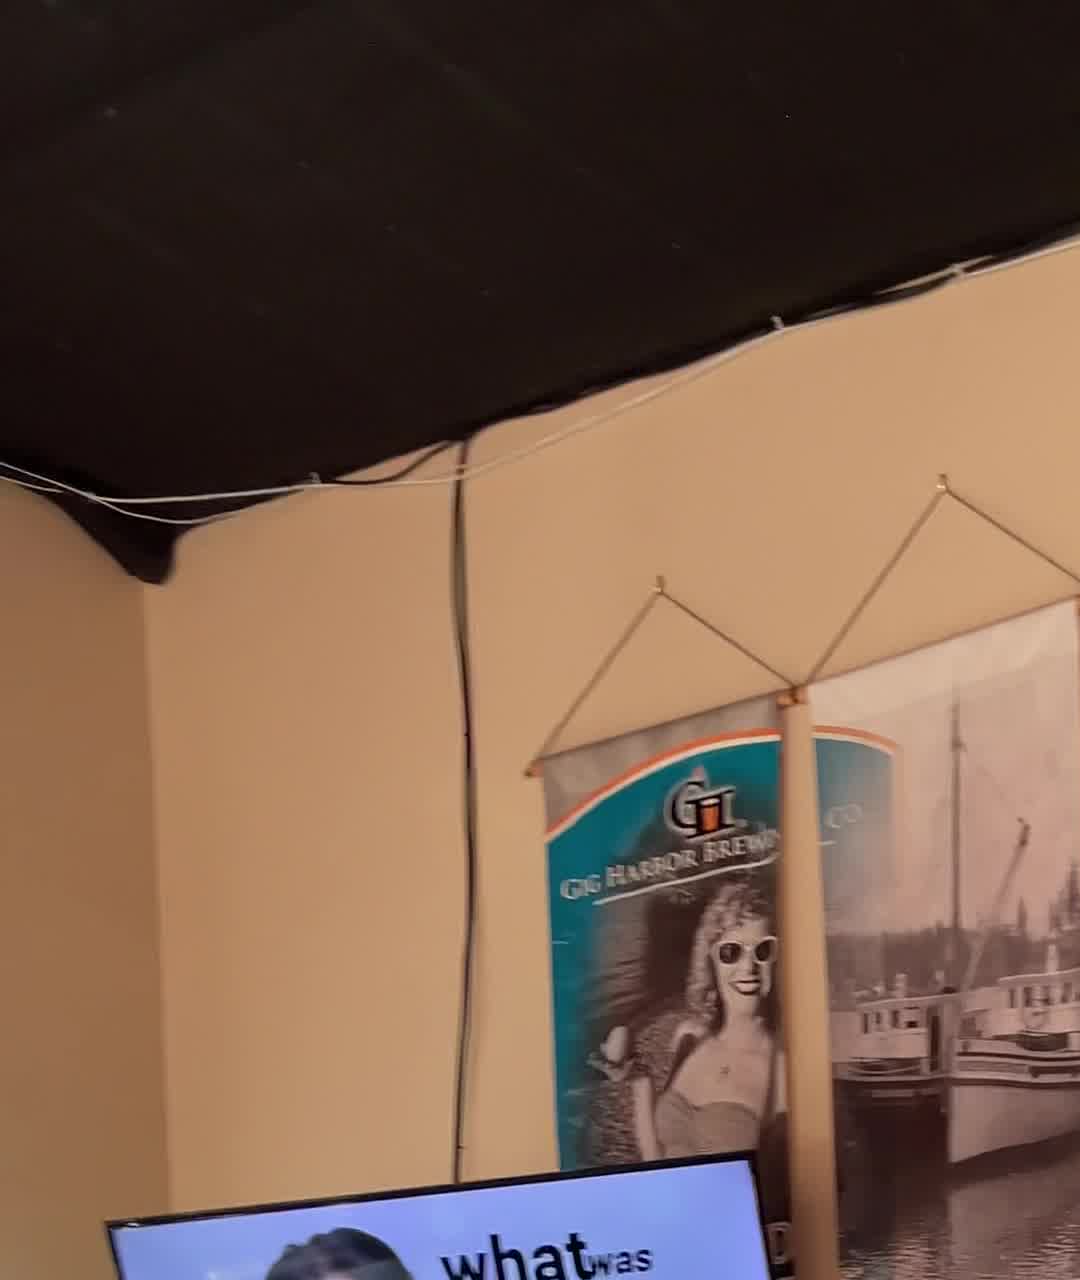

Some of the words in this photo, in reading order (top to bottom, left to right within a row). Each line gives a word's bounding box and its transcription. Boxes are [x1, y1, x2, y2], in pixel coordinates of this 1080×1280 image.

[560, 873, 601, 901] GIG
[605, 848, 701, 889] HARBOR
[587, 1248, 654, 1277] was
